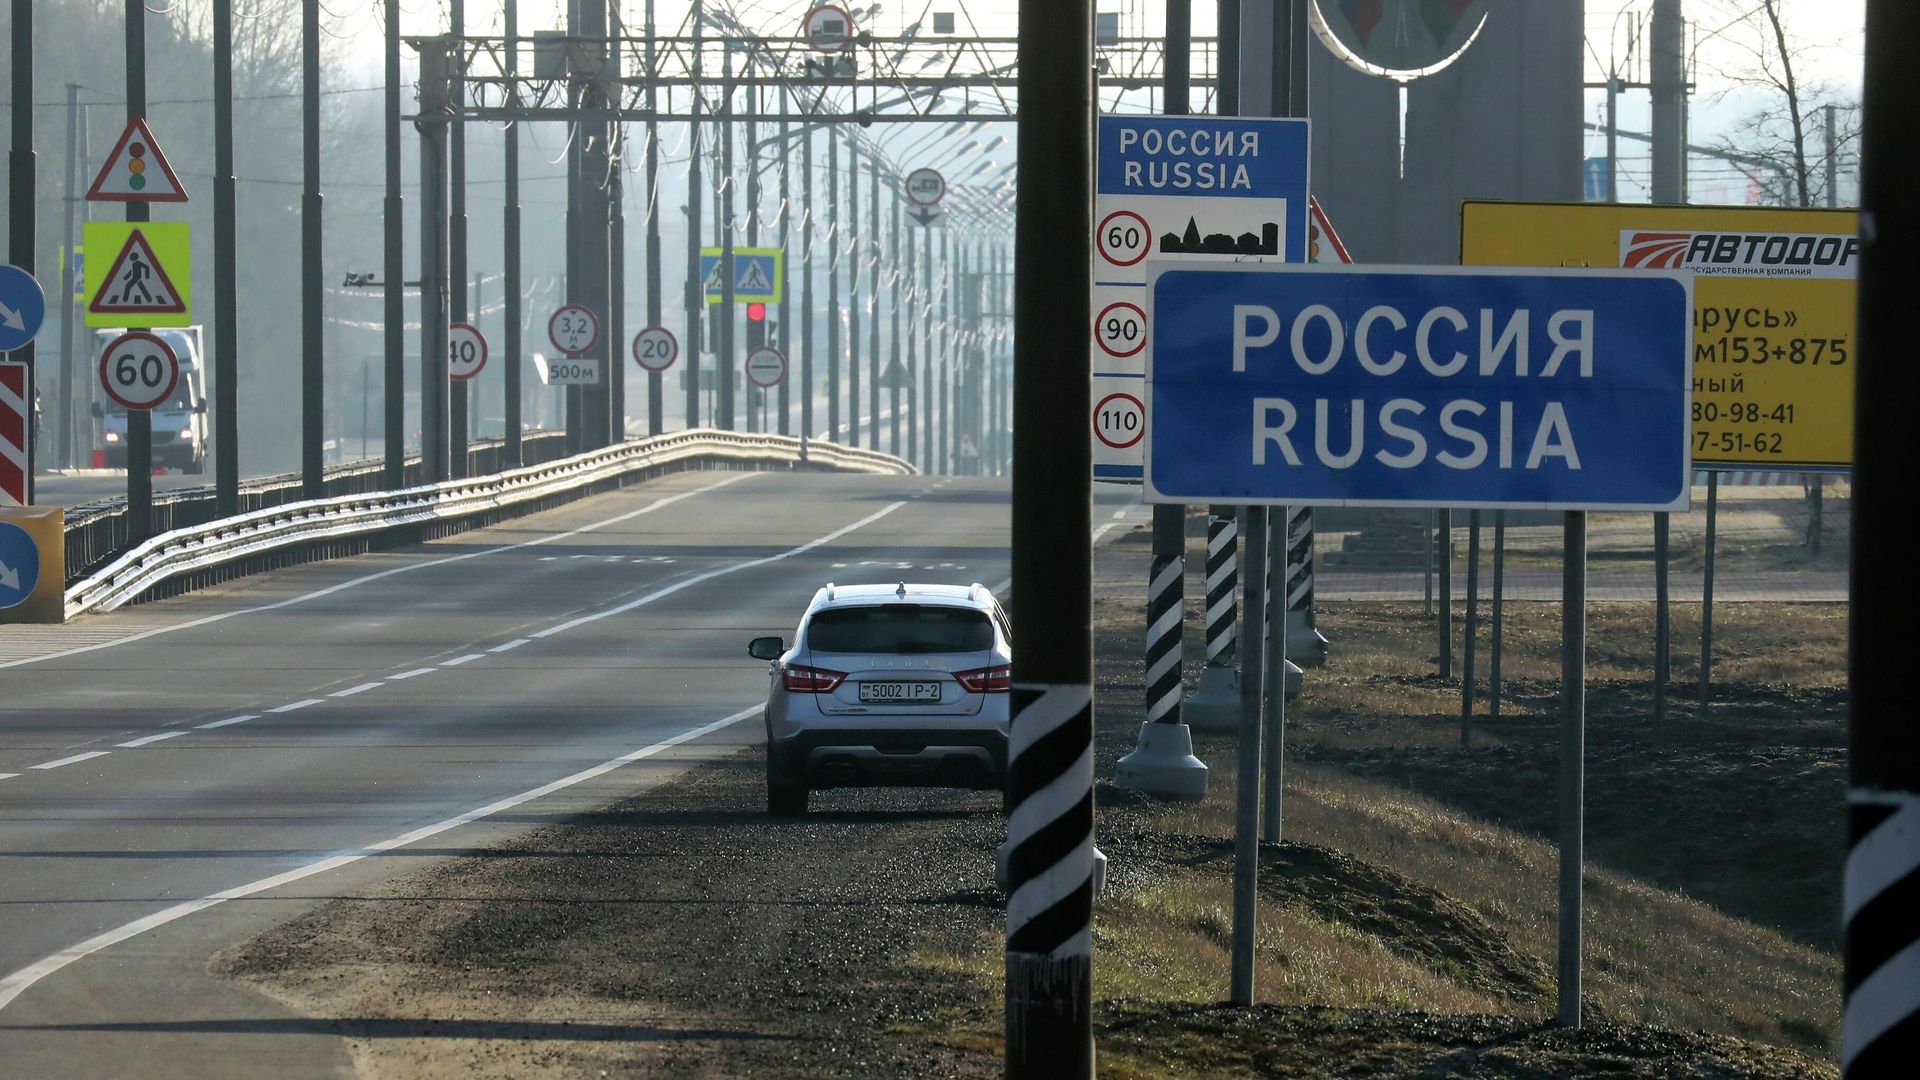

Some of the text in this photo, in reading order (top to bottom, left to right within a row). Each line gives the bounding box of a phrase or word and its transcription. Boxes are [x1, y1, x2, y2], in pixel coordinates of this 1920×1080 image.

[1119, 128, 1259, 157] РОССИЯ
[1124, 160, 1252, 189] RUSSIA
[1108, 226, 1140, 249] 60
[1766, 268, 1812, 276] КОМПАНИЯ
[1107, 318, 1138, 341] 90
[1693, 306, 1798, 334] русь»
[643, 338, 670, 359] 20
[1232, 304, 1594, 378] РОССИЯ
[115, 354, 163, 387] 60
[1102, 410, 1138, 431] 110
[1252, 397, 1582, 470] RUSSIA
[1691, 432, 1783, 454] 7-51-62
[872, 684, 903, 698] 5002
